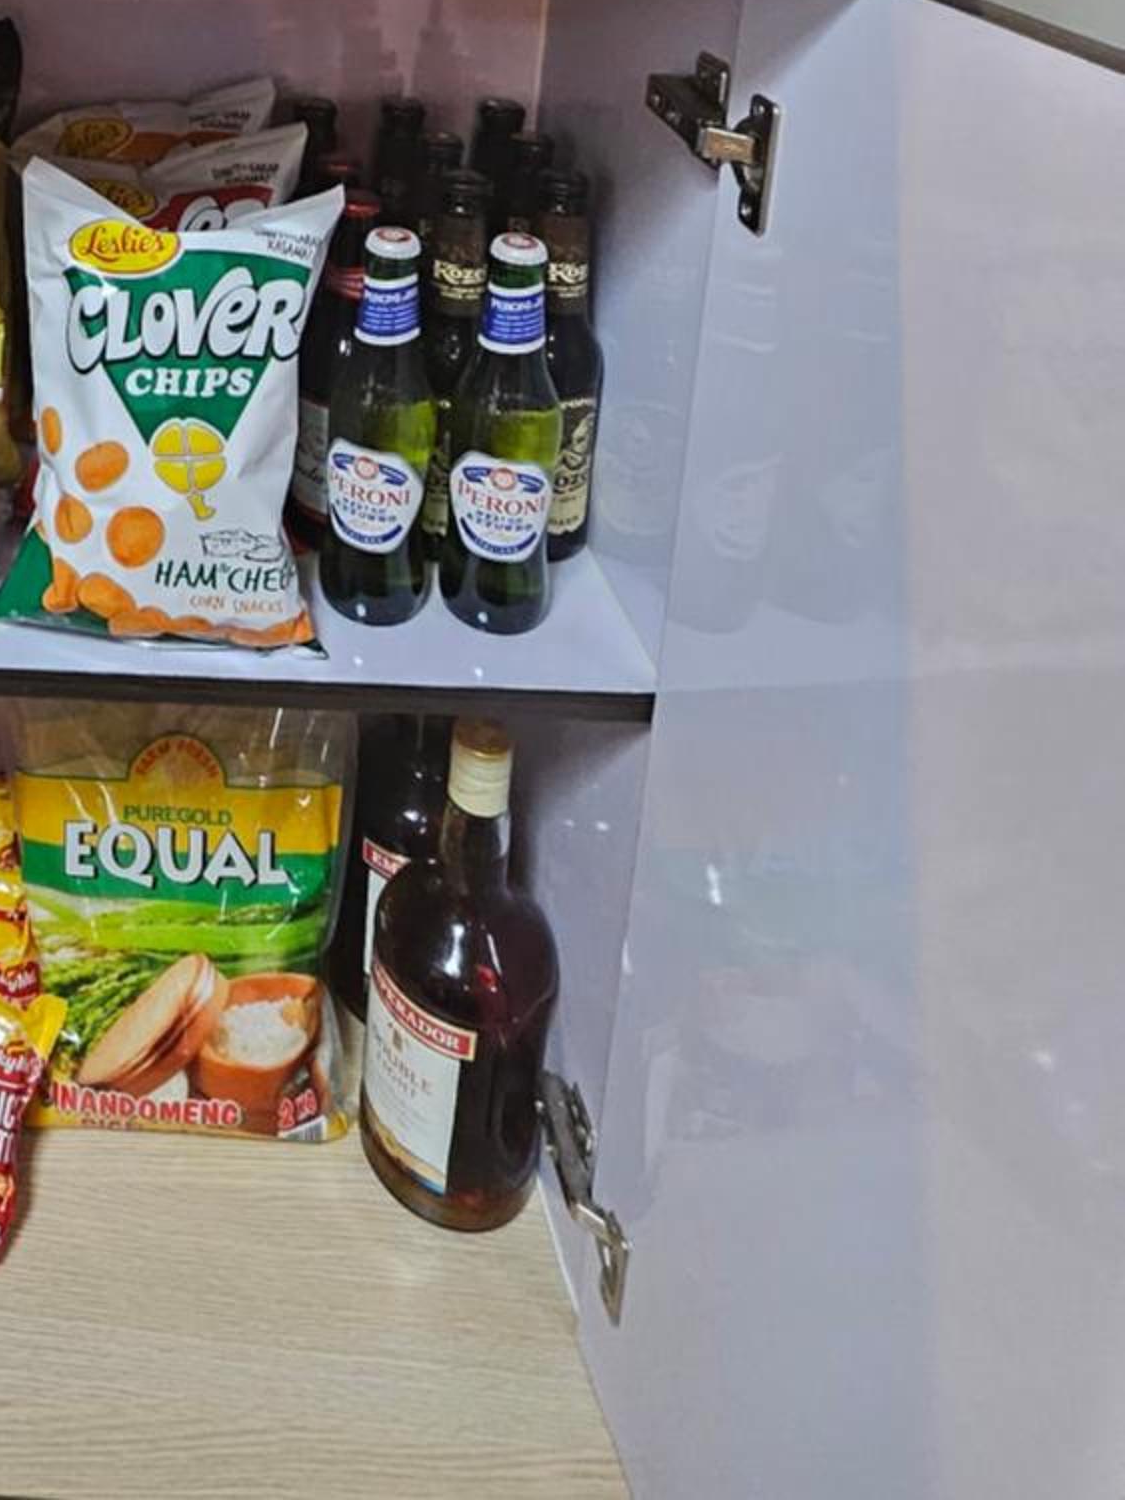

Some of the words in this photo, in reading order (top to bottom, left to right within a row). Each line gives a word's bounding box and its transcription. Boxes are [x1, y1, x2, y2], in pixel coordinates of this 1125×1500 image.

[82, 227, 165, 263] Leslie's
[125, 367, 254, 397] CHIPS
[330, 469, 411, 508] PERONI
[458, 479, 546, 517] PERONI
[123, 804, 233, 826] PUREGOLD
[64, 819, 292, 890] EQUAL
[49, 1082, 242, 1126] INANDOMENG
[278, 1097, 296, 1129] 2
